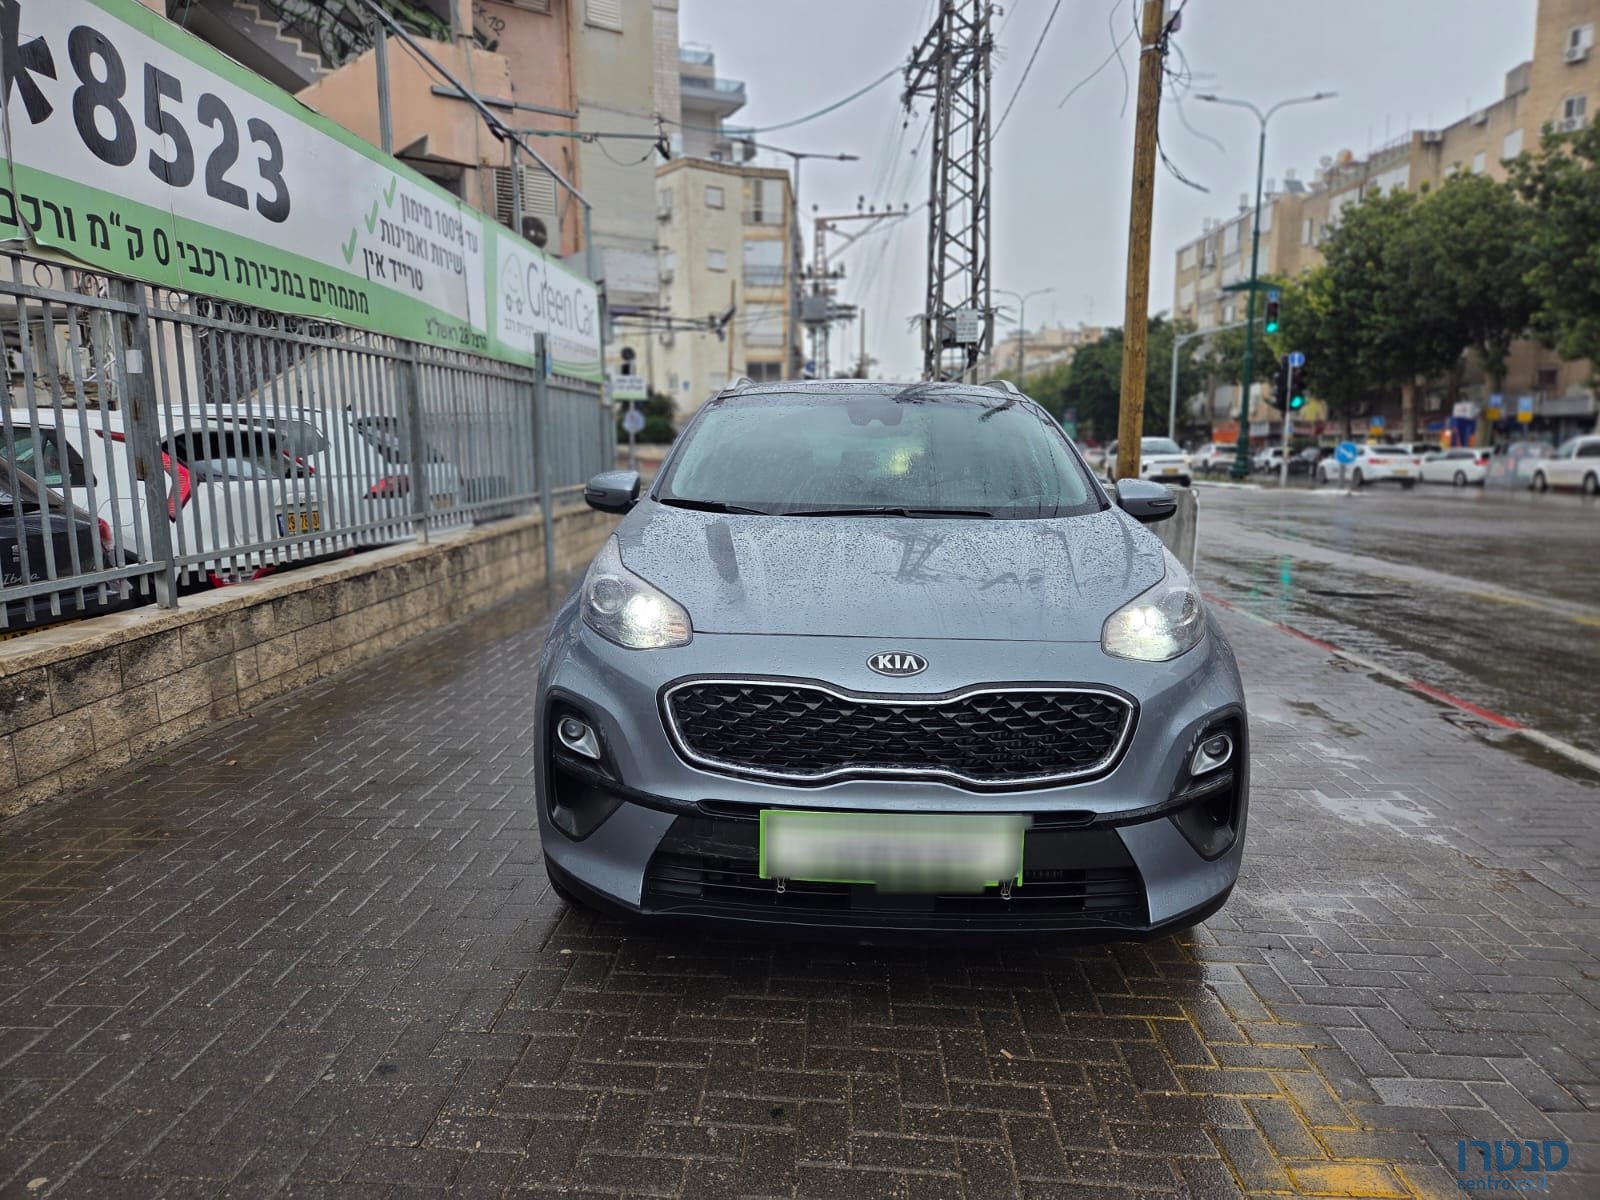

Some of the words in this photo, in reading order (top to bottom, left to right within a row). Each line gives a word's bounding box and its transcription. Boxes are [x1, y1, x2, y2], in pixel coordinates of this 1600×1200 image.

[400, 193, 432, 230] מימון
[434, 209, 464, 246] 100%
[86, 210, 144, 261] ק"מ
[153, 228, 170, 266] 0
[380, 218, 428, 261] ואמינות
[465, 229, 478, 253] עד
[177, 240, 230, 281] רכבי
[363, 248, 386, 281] אין
[388, 257, 424, 291] טרייד
[430, 241, 463, 275] שירות
[235, 256, 305, 299] במכירת
[309, 277, 369, 315] מתמחים
[526, 262, 573, 330] Green
[574, 287, 596, 337] Car
[877, 654, 919, 670] KIA
